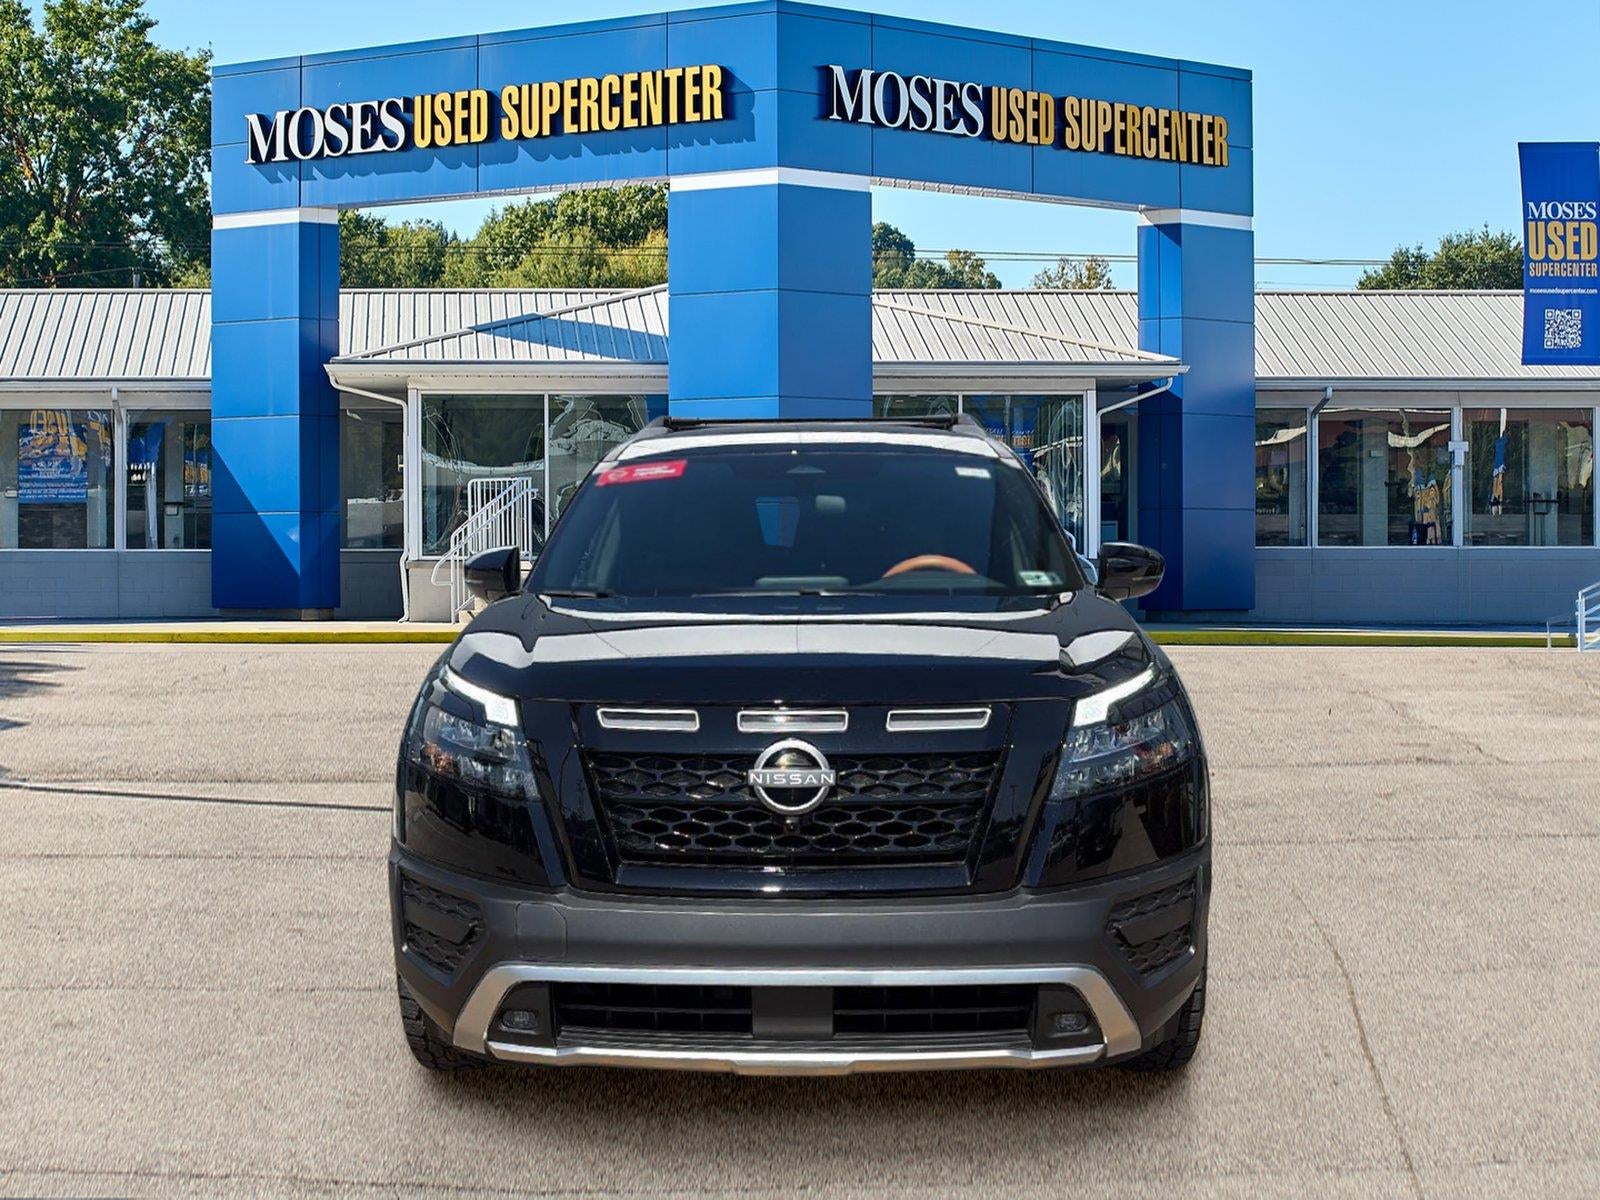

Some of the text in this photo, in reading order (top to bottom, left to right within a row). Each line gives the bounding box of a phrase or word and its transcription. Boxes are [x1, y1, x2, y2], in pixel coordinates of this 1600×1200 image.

[244, 64, 723, 164] MOSES USED SUPERCENTER
[828, 64, 1230, 167] MOSES USED SUPERCENTER
[1527, 201, 1597, 219] MOSES
[1528, 221, 1597, 260] USED
[1529, 262, 1597, 277] SUPERCENTER
[1529, 287, 1598, 295] mosesusedsupercenter.com
[750, 773, 834, 785] NISSAN
